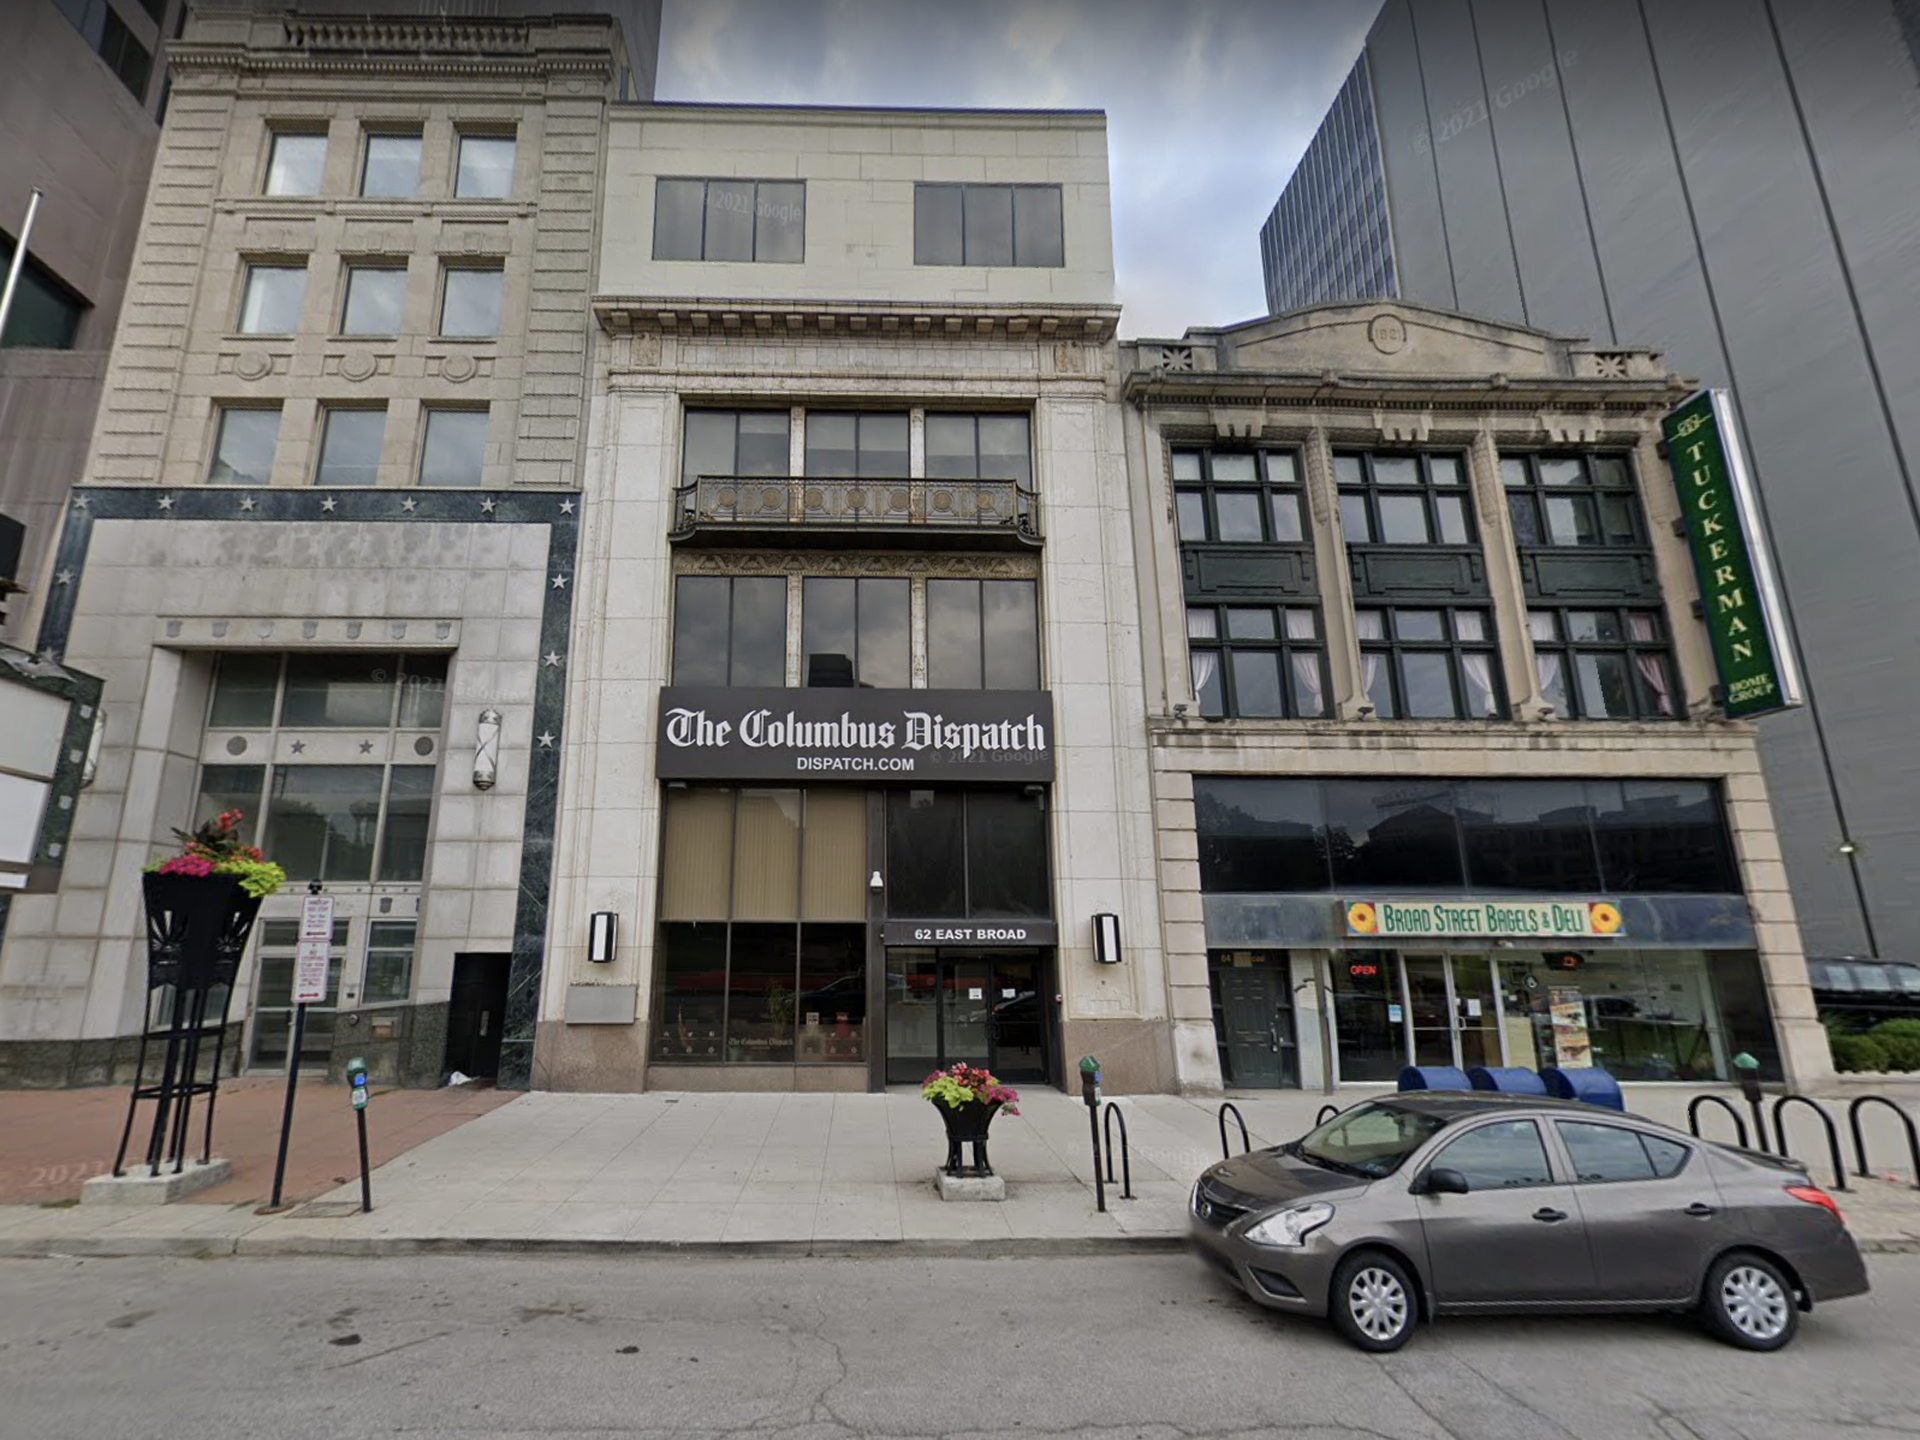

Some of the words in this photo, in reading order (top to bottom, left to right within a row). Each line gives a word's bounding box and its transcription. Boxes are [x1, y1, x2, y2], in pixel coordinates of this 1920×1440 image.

[1686, 441, 1754, 662] TUCKERMAN
[1729, 673, 1769, 692] HOME
[1728, 683, 1774, 704] GROUP
[665, 707, 732, 748] The
[739, 708, 896, 749] Columbus
[901, 710, 1047, 759] Dispatch
[797, 757, 915, 772] DISPATCH.COM
[1383, 904, 1431, 932] BROAD
[1434, 904, 1482, 932] STREET
[1485, 905, 1538, 932] BAGELS
[1541, 911, 1551, 928] &
[1552, 904, 1583, 932] DELI
[914, 928, 932, 940] 62
[935, 928, 973, 940] EAST
[977, 928, 1027, 940] BROAD
[1350, 965, 1377, 975] OPEN
